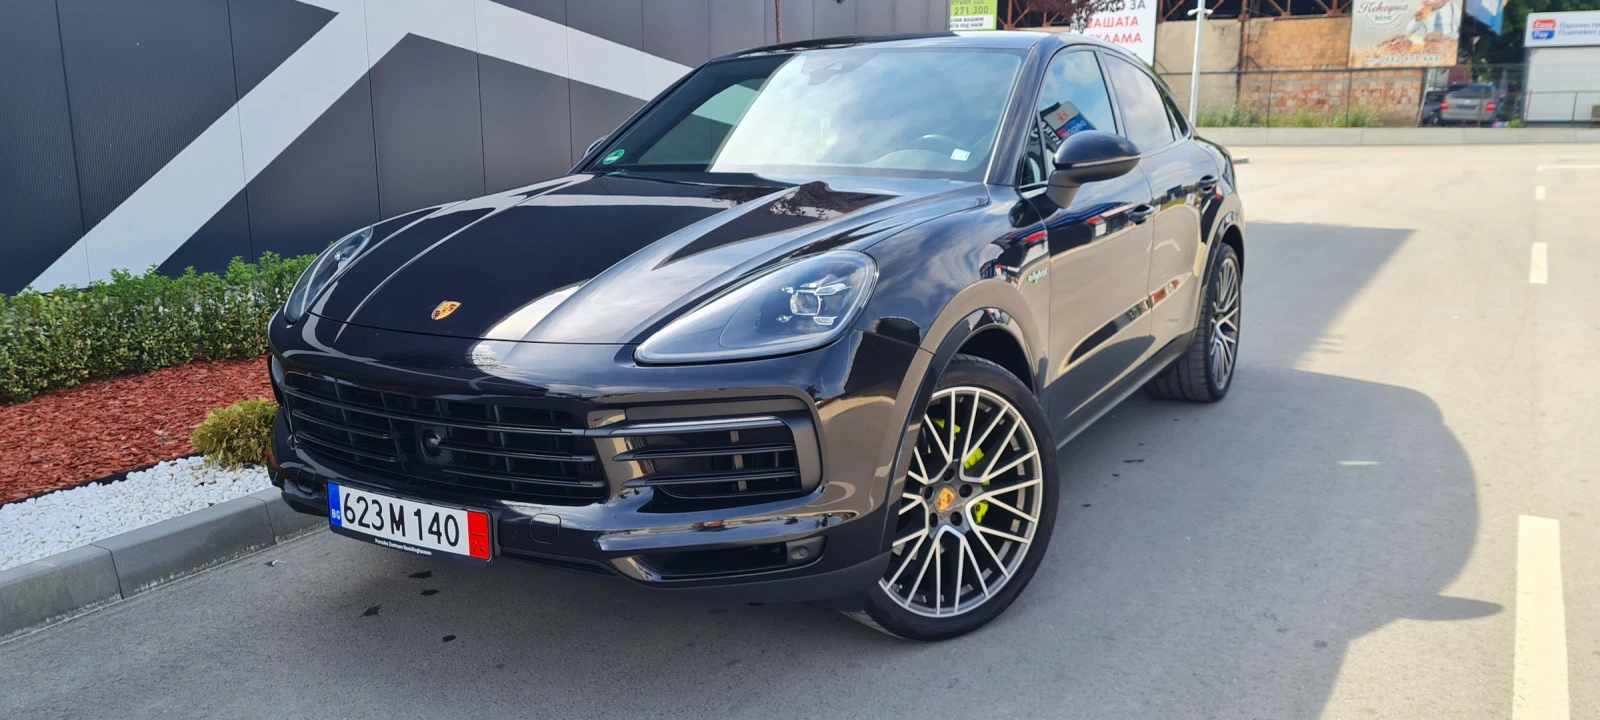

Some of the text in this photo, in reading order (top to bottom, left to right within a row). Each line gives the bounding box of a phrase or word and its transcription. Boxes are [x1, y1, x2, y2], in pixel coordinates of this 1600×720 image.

[954, 5, 989, 15] 271 300
[1130, 0, 1146, 10] ЗА
[331, 508, 341, 520] BG
[343, 492, 460, 547] 623 M 140
[472, 540, 486, 554] 24
